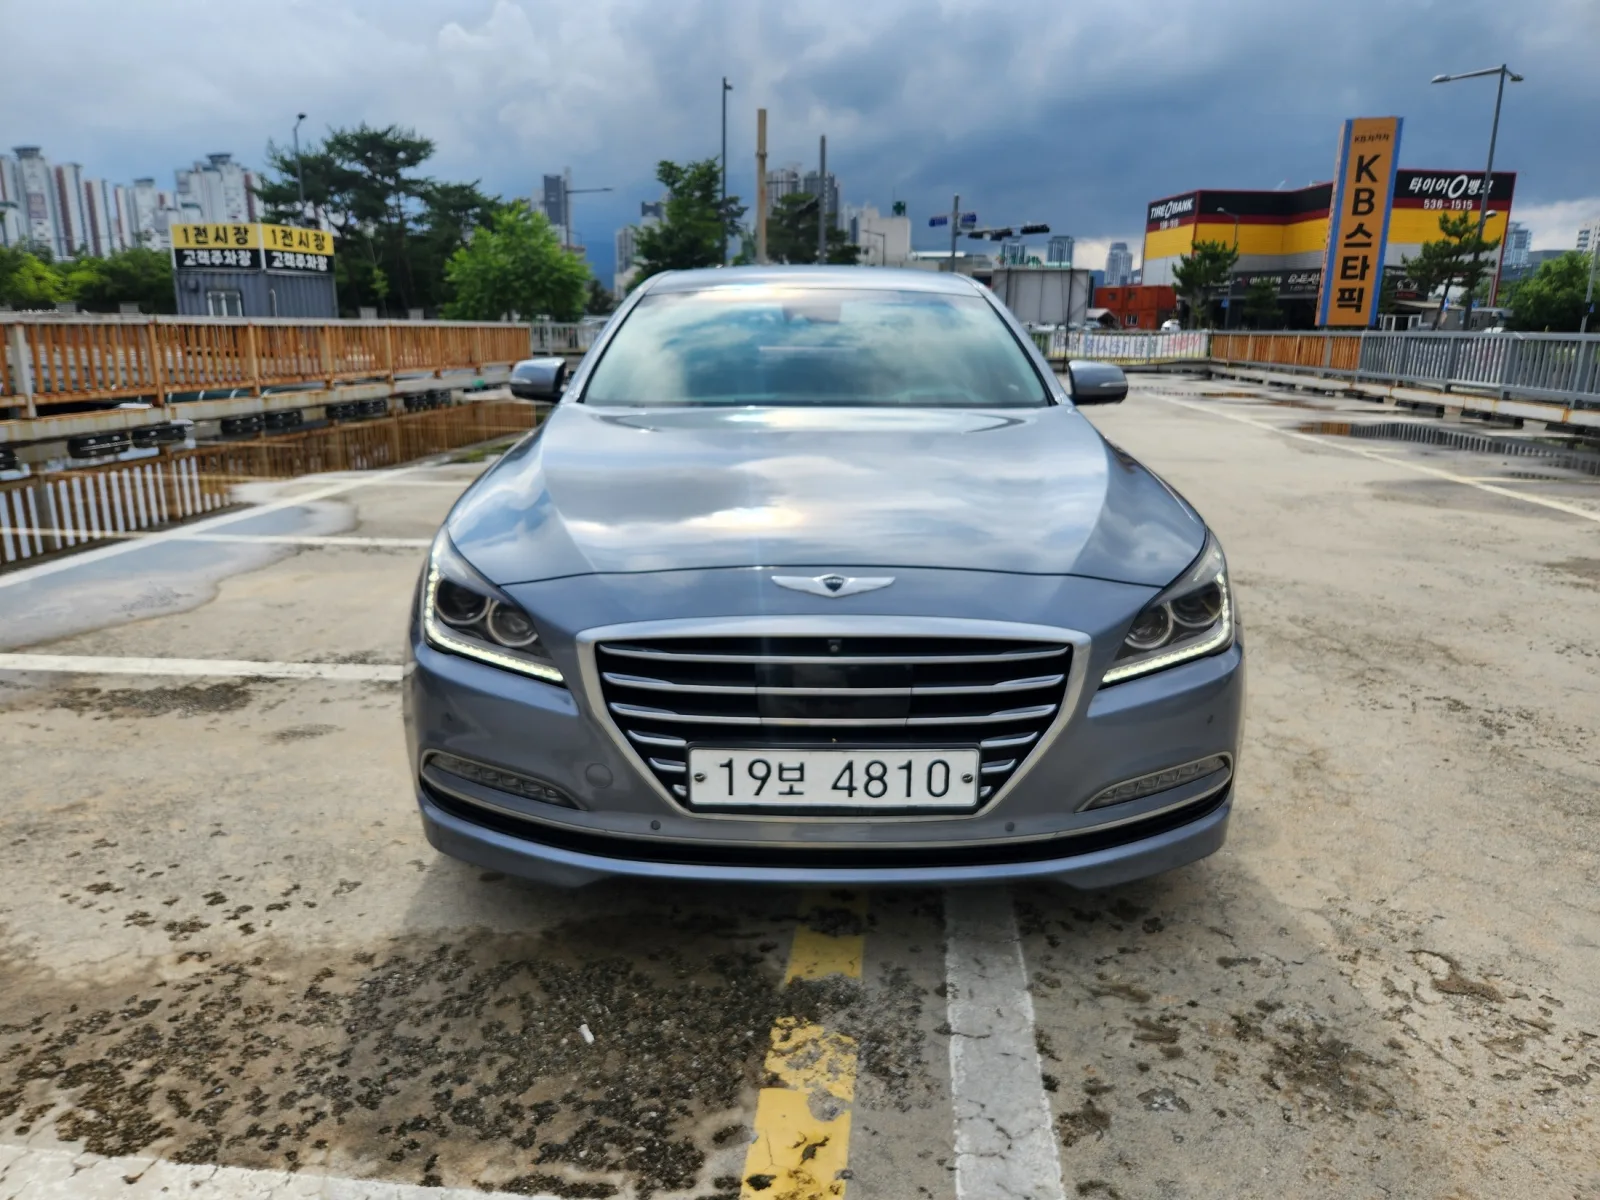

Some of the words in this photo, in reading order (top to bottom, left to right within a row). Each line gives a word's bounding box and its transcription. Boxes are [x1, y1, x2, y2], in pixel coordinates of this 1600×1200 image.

[182, 226, 249, 245] 1전시장
[271, 229, 325, 251] 1전시장
[1336, 154, 1381, 313] KB스타픽
[183, 249, 251, 267] 고객주차장
[271, 251, 328, 272] 고객주차장
[719, 757, 806, 797] 19보
[830, 758, 951, 799] 4810
